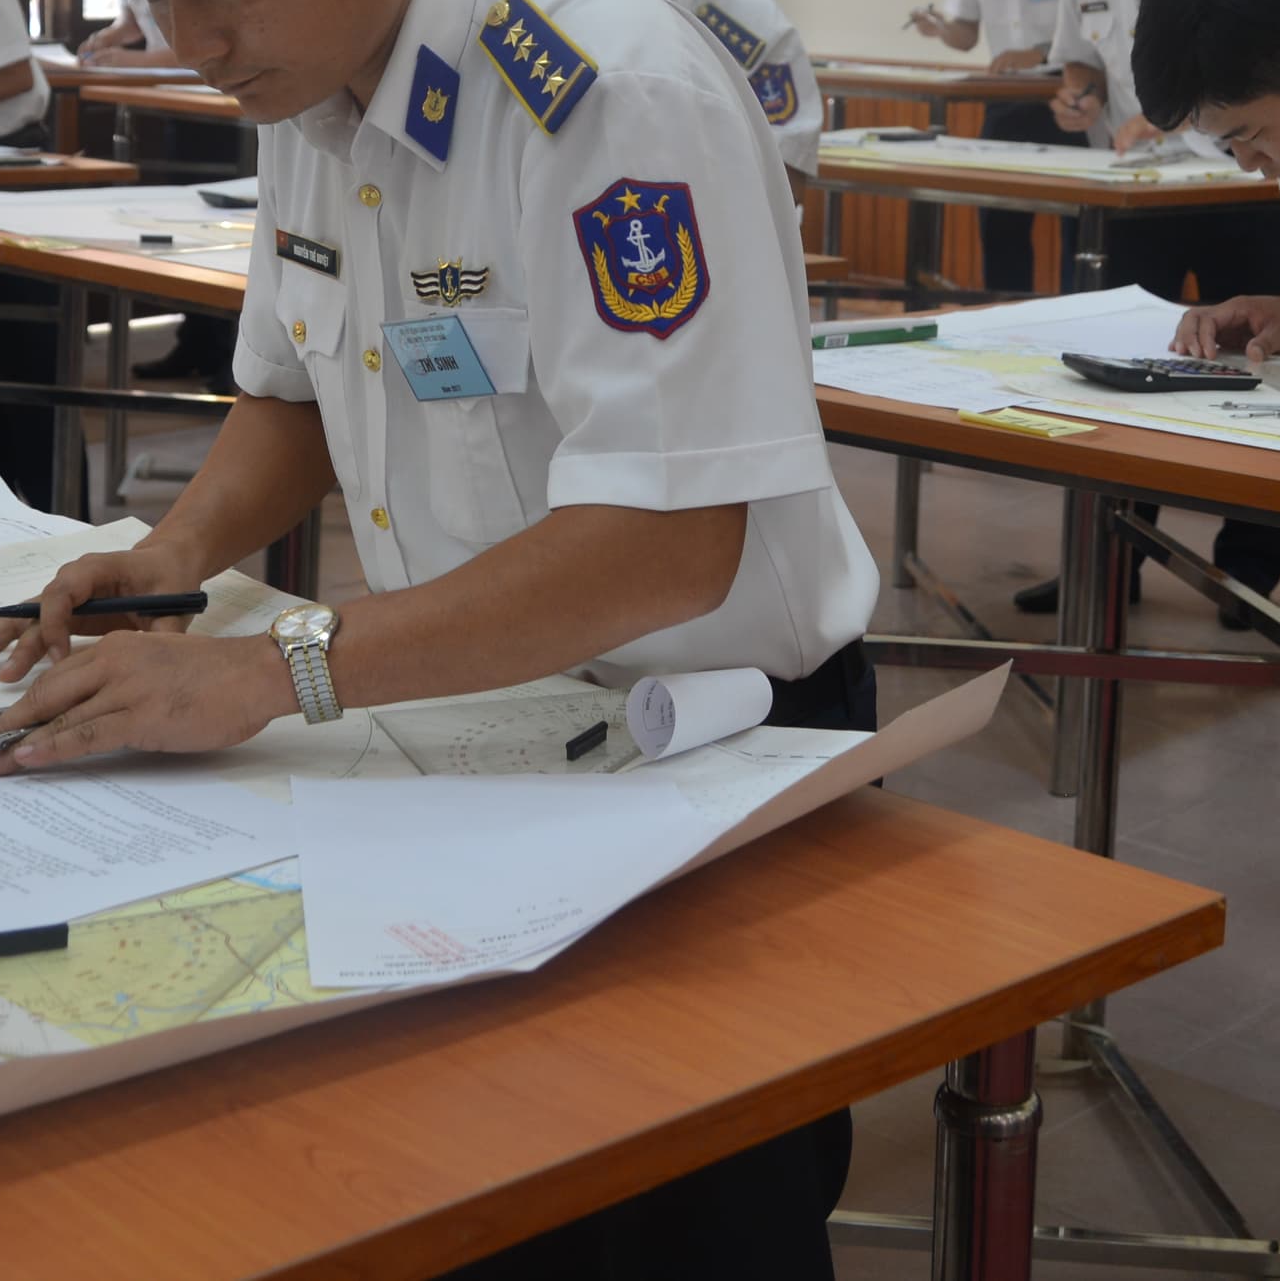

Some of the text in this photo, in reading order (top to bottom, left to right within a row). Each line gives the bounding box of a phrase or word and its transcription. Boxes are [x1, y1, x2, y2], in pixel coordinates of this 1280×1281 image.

[635, 271, 664, 285] CSB
[419, 355, 460, 373] THÍ SINH
